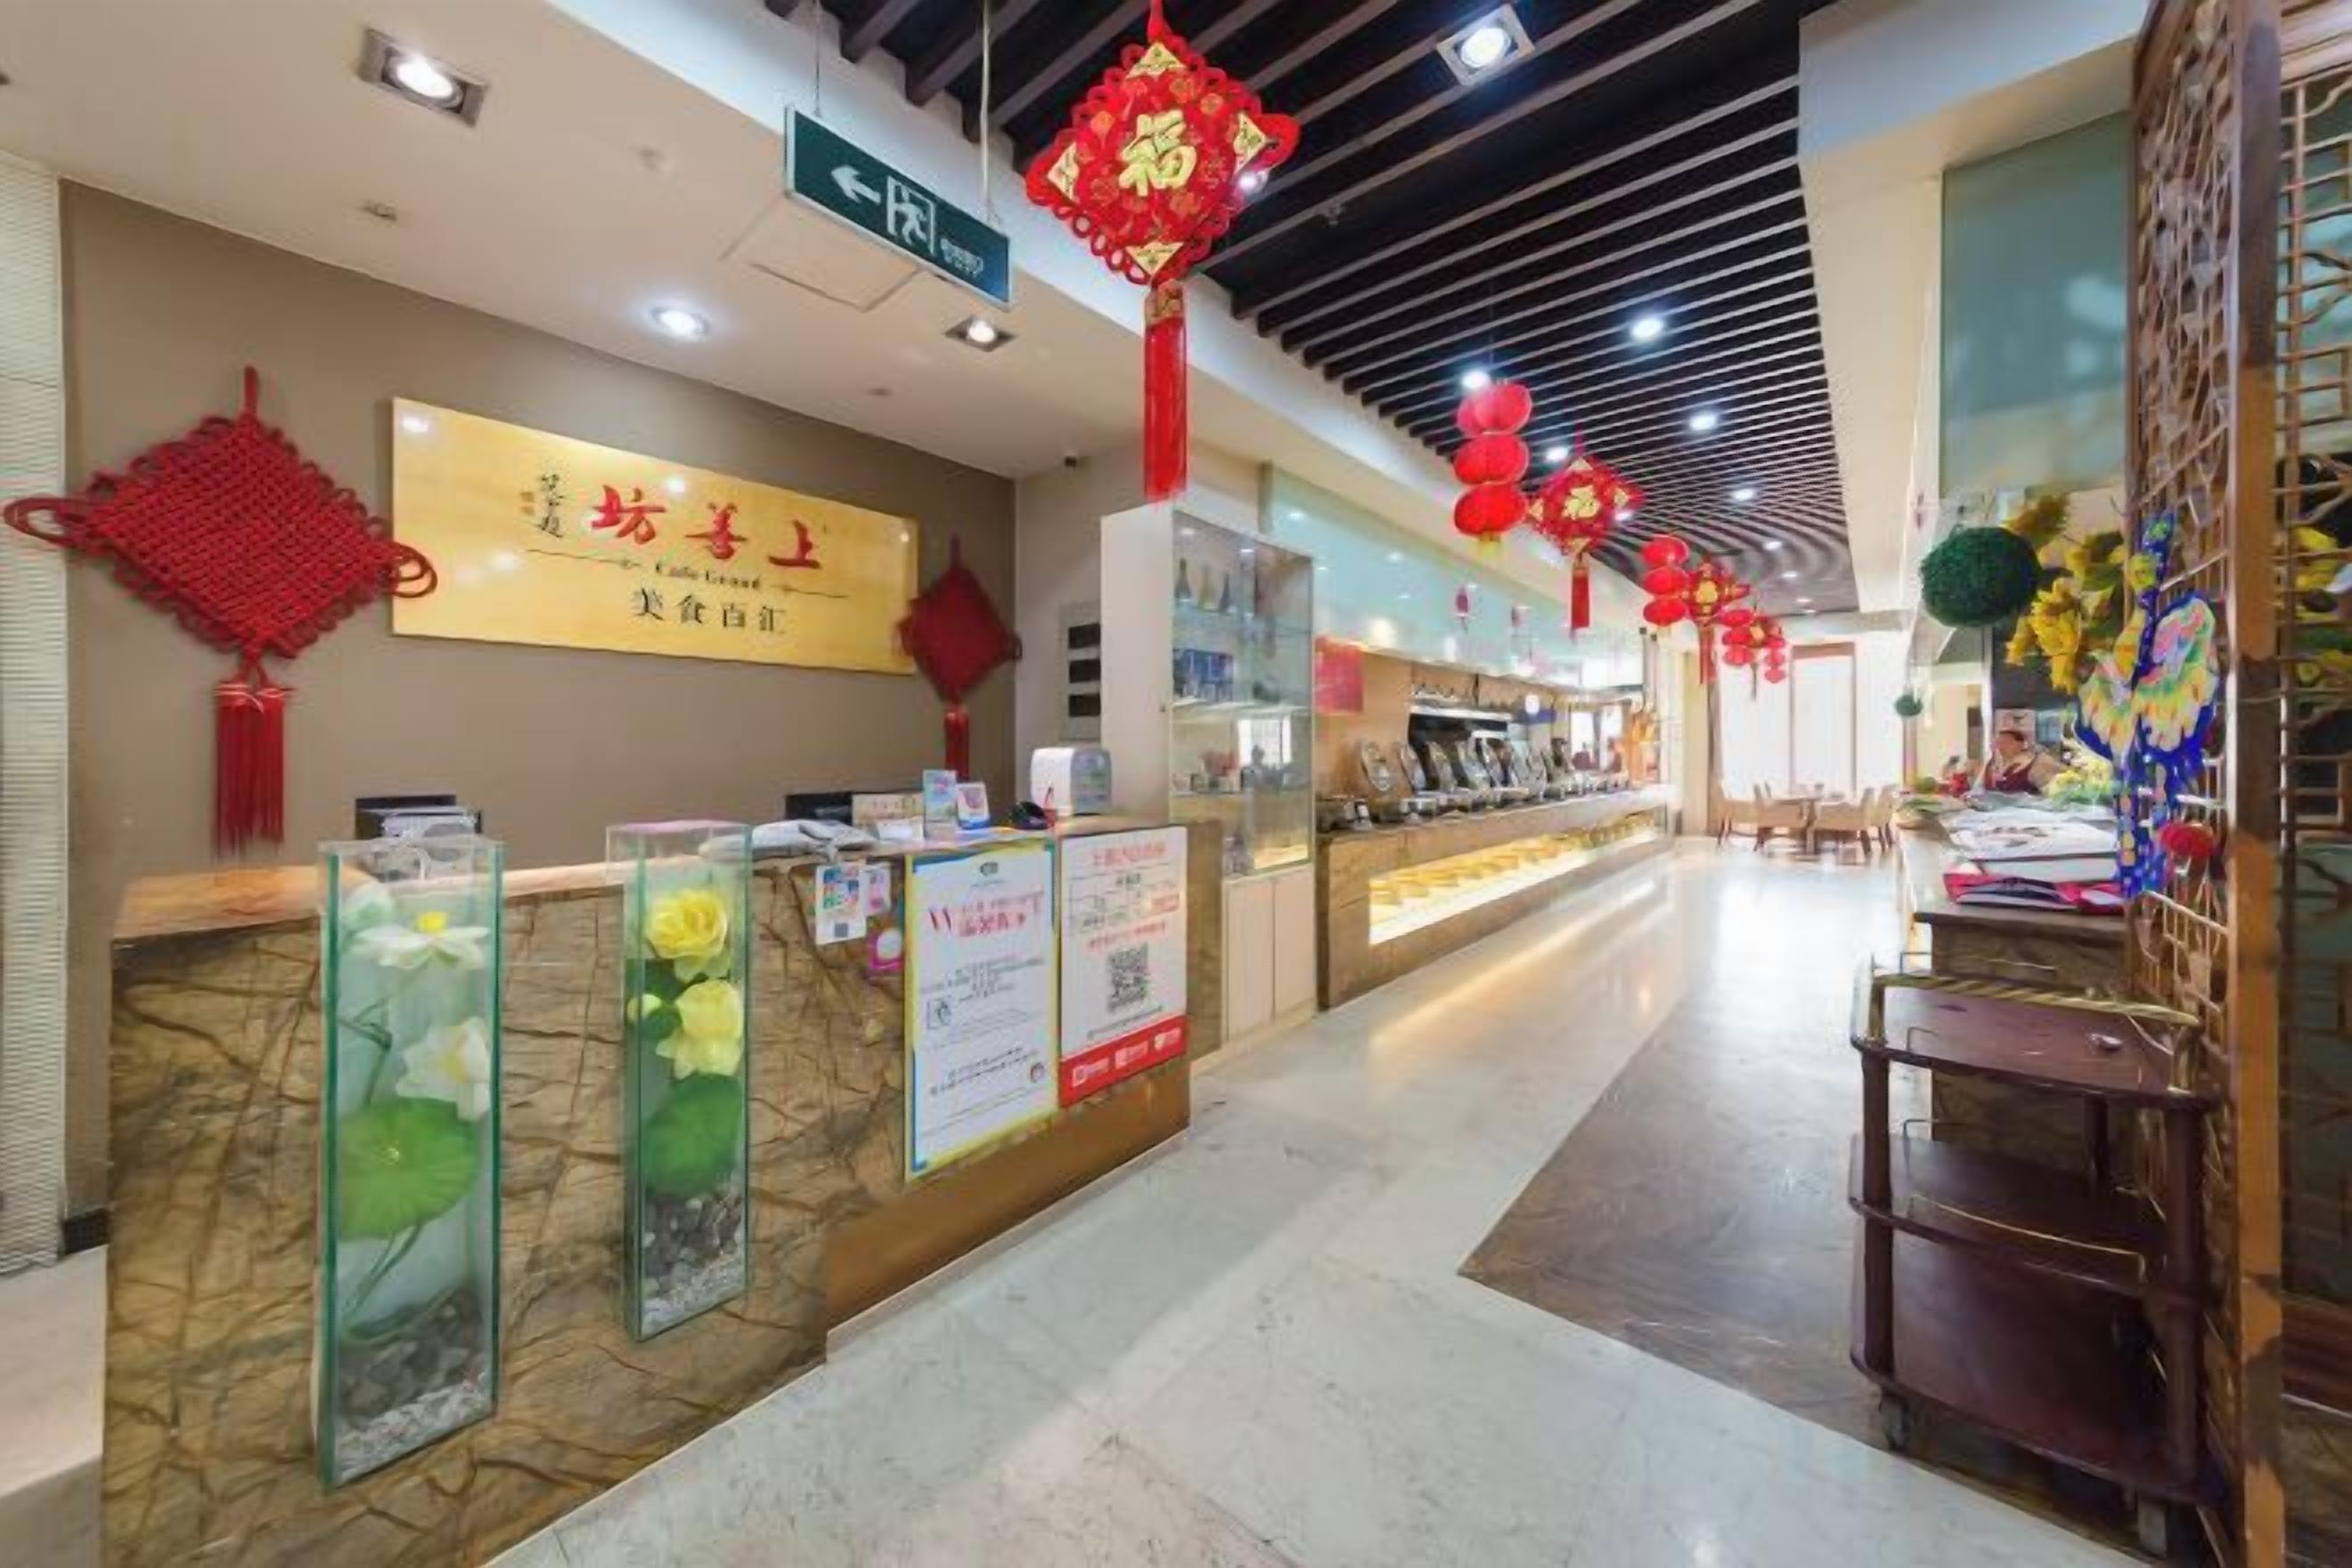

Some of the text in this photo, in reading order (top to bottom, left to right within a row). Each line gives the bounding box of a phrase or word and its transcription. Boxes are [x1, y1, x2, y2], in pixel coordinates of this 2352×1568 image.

[1119, 109, 1197, 197] 福
[631, 585, 788, 633] 美食百汇
